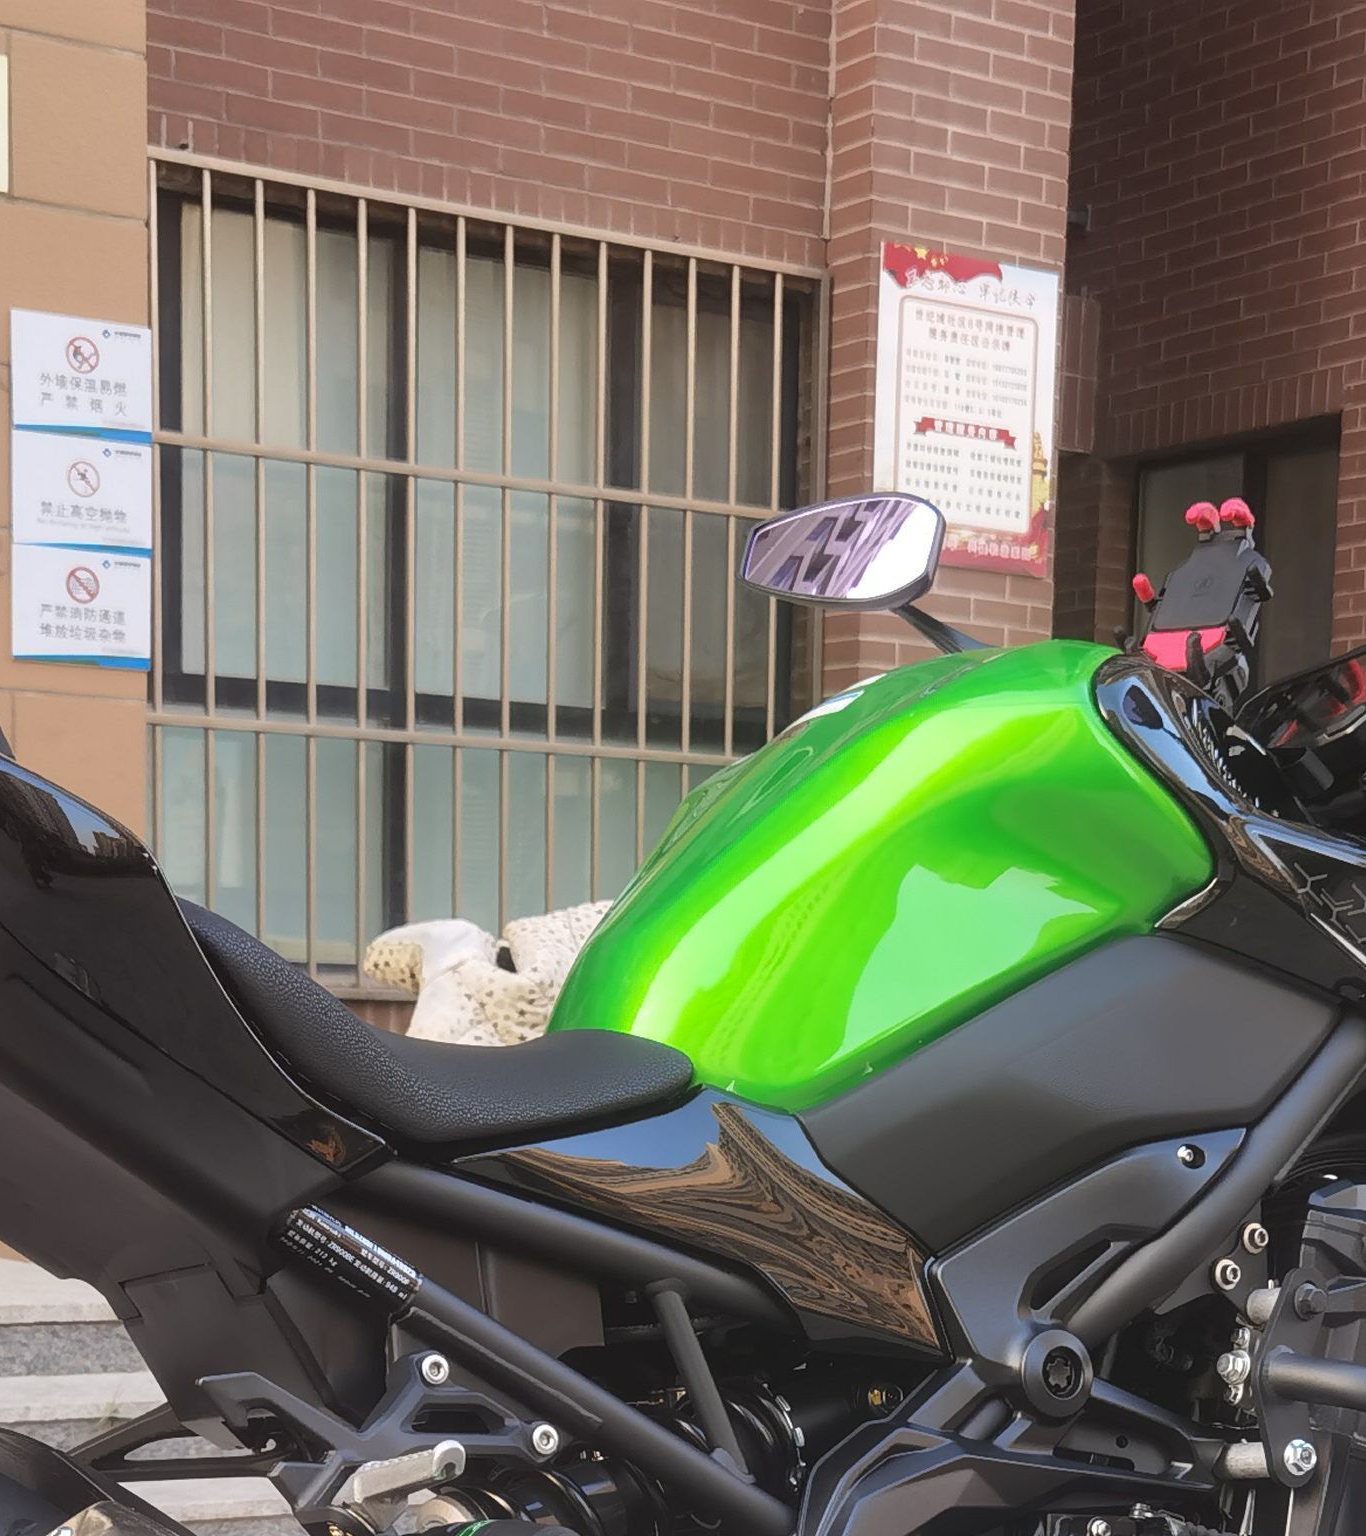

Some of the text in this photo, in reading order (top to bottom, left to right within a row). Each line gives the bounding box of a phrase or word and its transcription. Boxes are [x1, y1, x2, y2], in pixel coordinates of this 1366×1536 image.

[39, 373, 128, 398] 外墙保温易燃
[39, 391, 128, 417] 严禁烟火
[40, 500, 128, 525] 禁止高空抛物
[40, 603, 127, 627] 严禁消防通道
[40, 622, 127, 644] 堆放垃圾杂物
